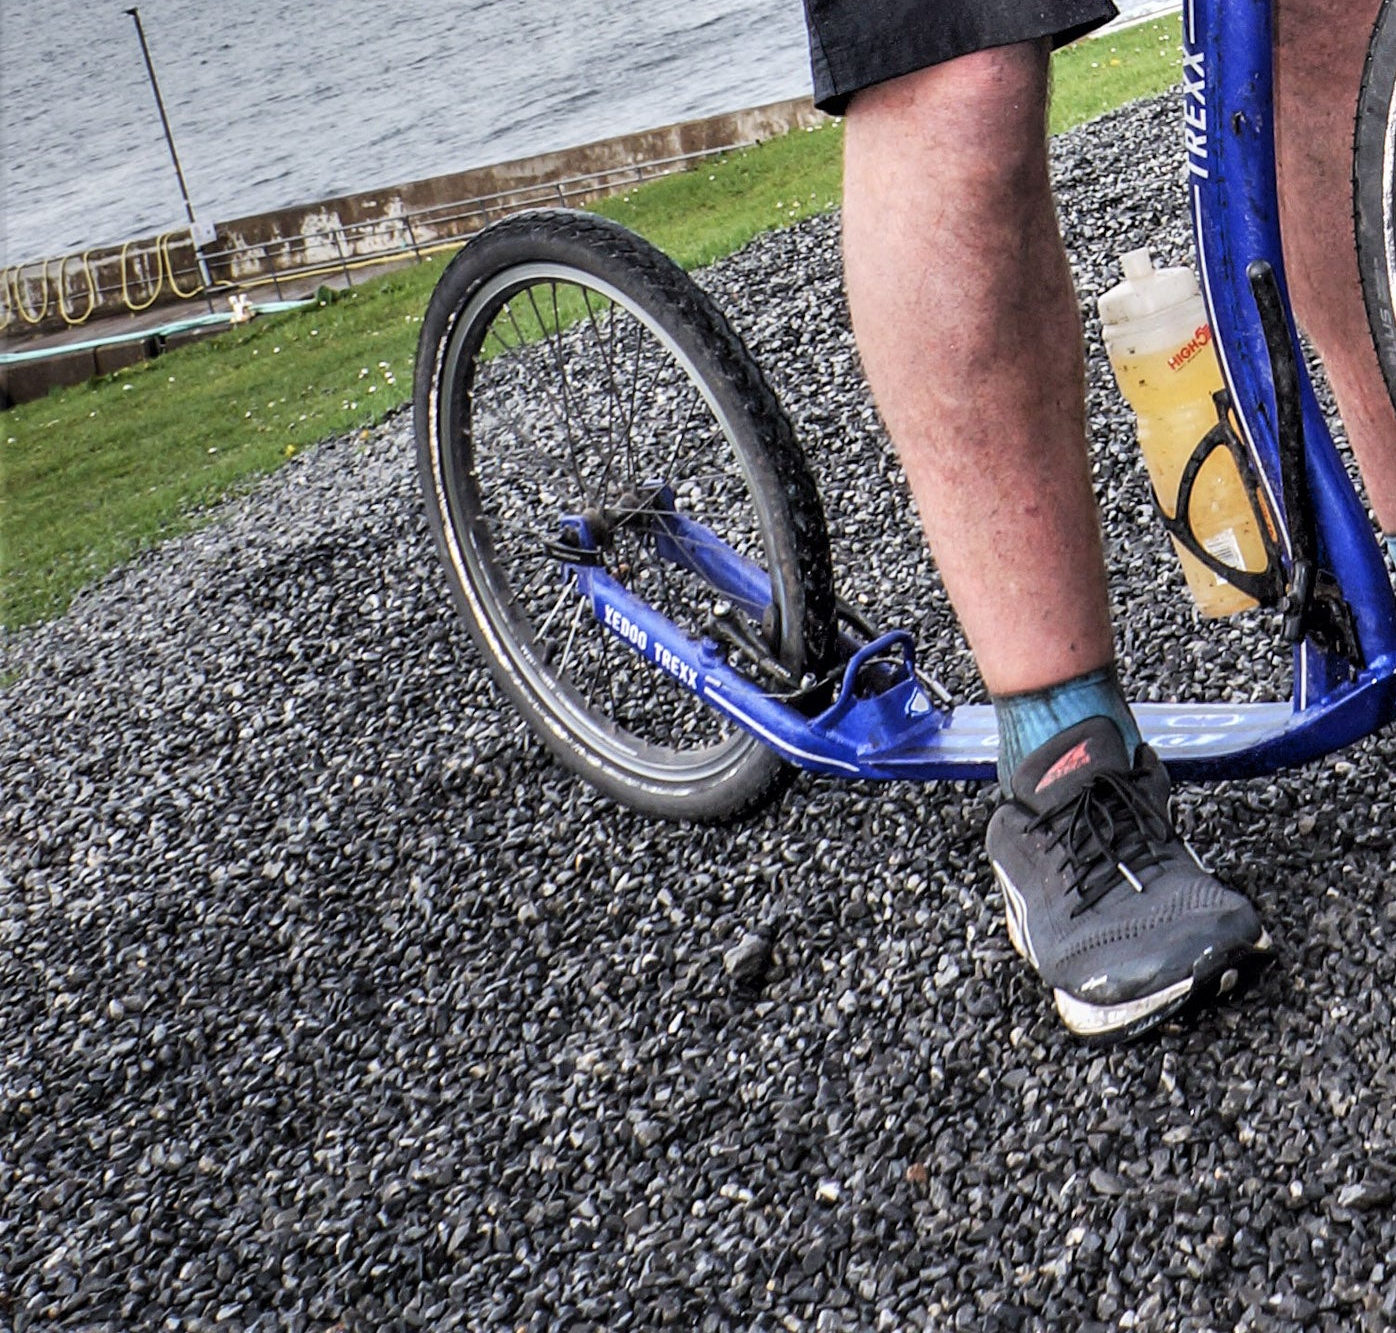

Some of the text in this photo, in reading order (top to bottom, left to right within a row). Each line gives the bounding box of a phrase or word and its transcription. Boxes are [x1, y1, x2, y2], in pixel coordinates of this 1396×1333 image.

[1182, 45, 1209, 179] TREXX
[604, 604, 698, 690] YEDOO TREXX
